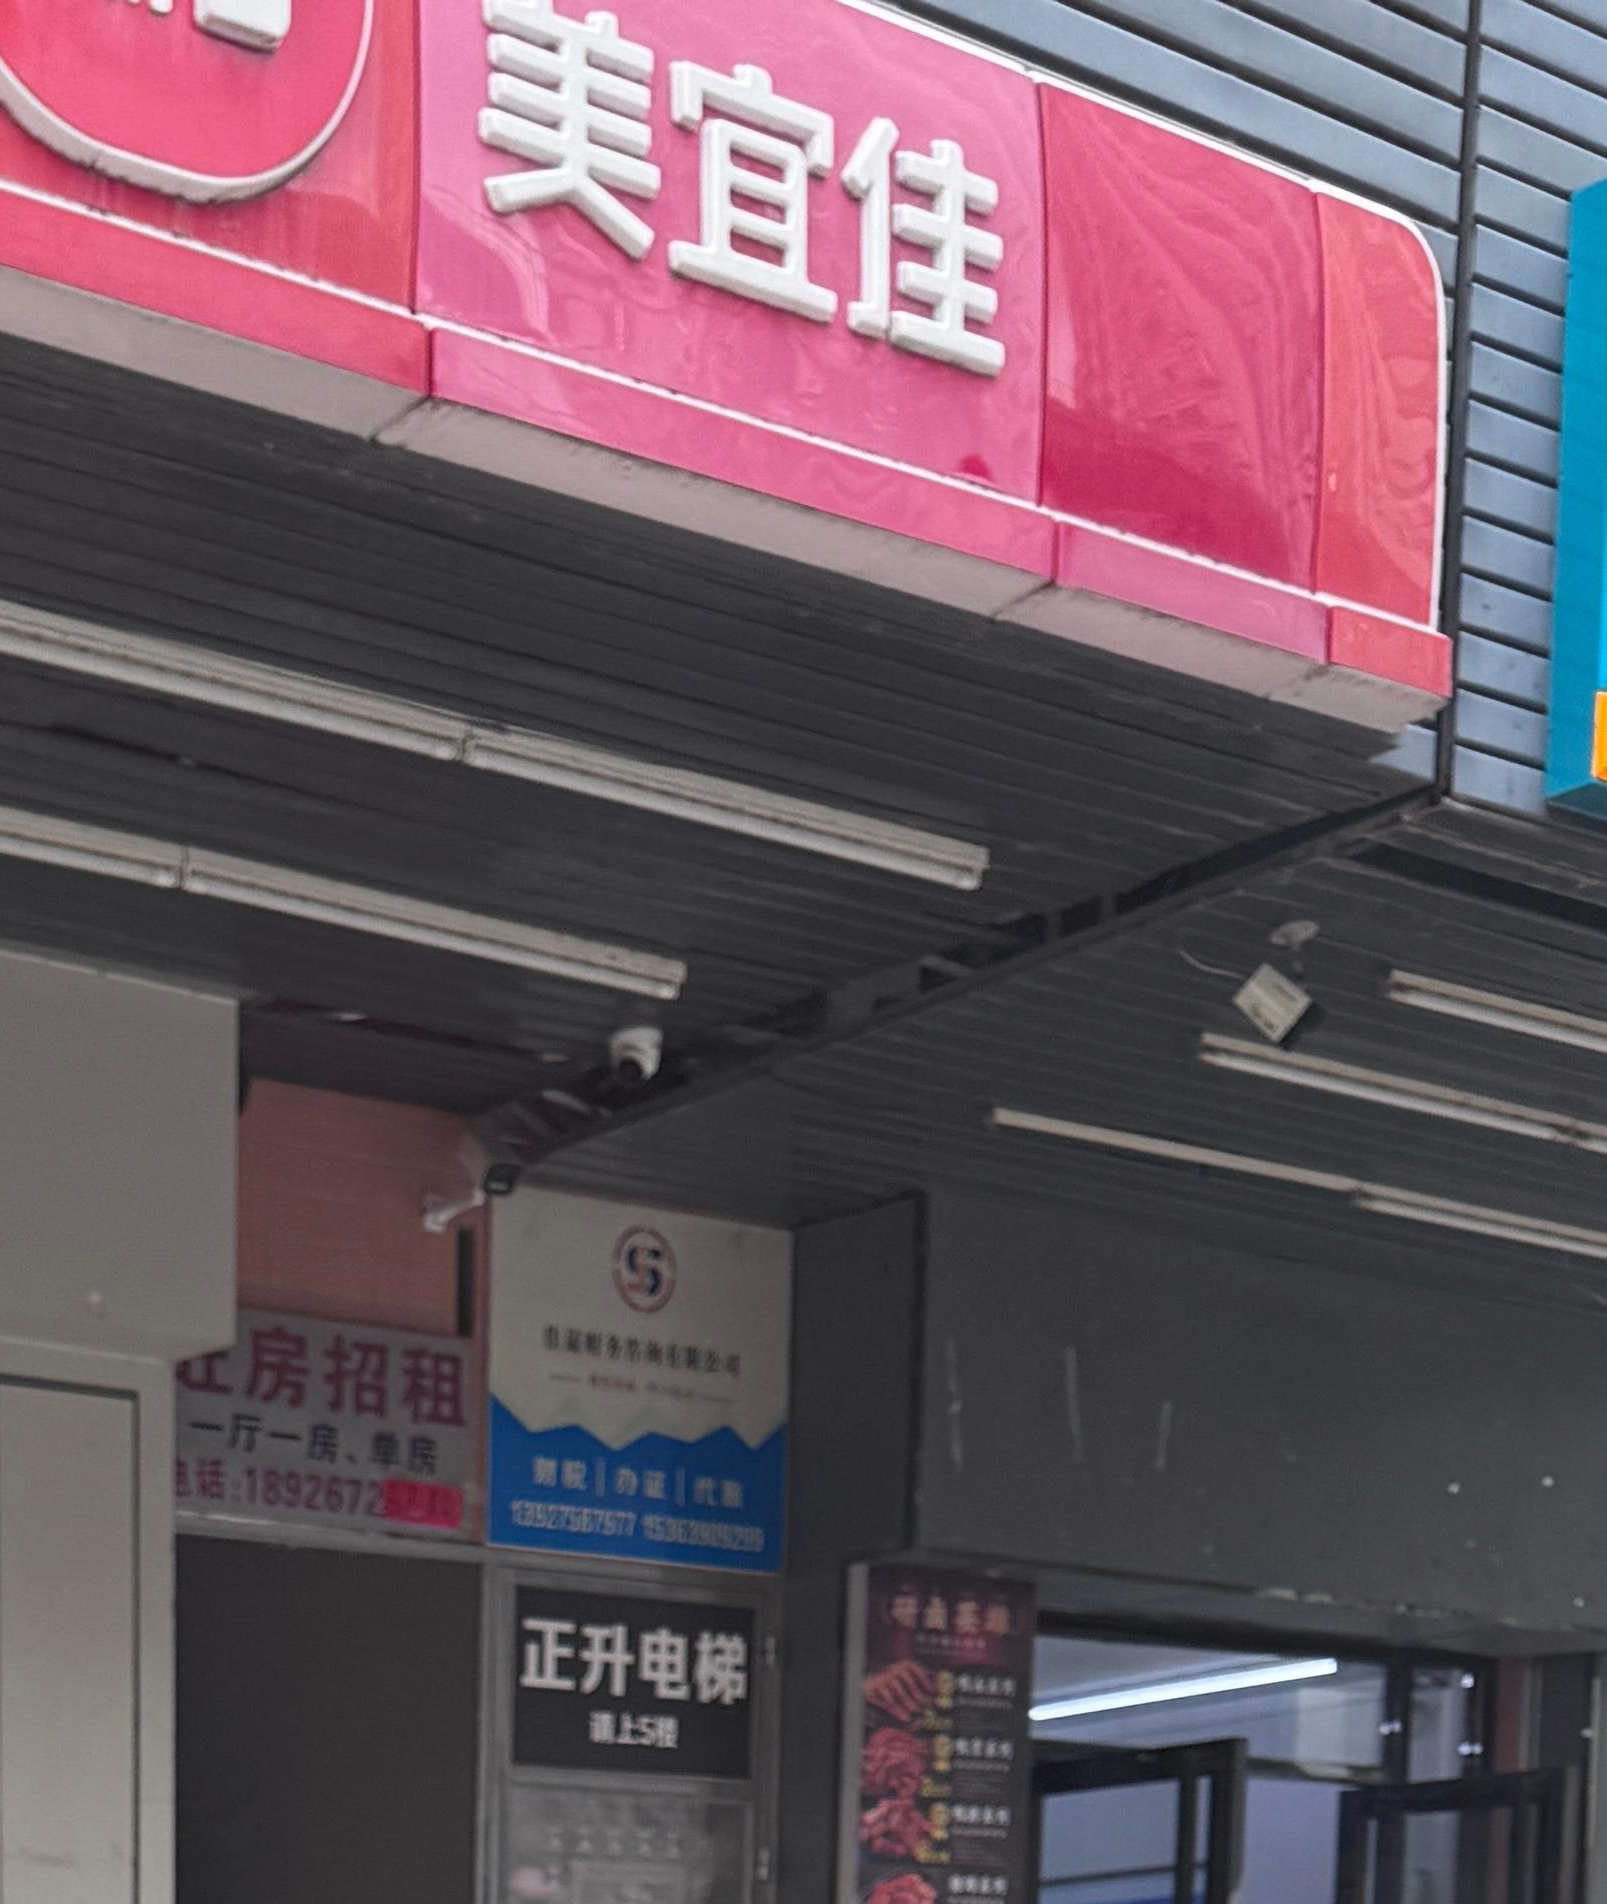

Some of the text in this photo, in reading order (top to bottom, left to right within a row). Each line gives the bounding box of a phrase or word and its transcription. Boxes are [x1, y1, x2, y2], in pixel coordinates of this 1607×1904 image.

[479, 0, 1006, 377] 美宜佳
[520, 1616, 748, 1705] 正升电梯
